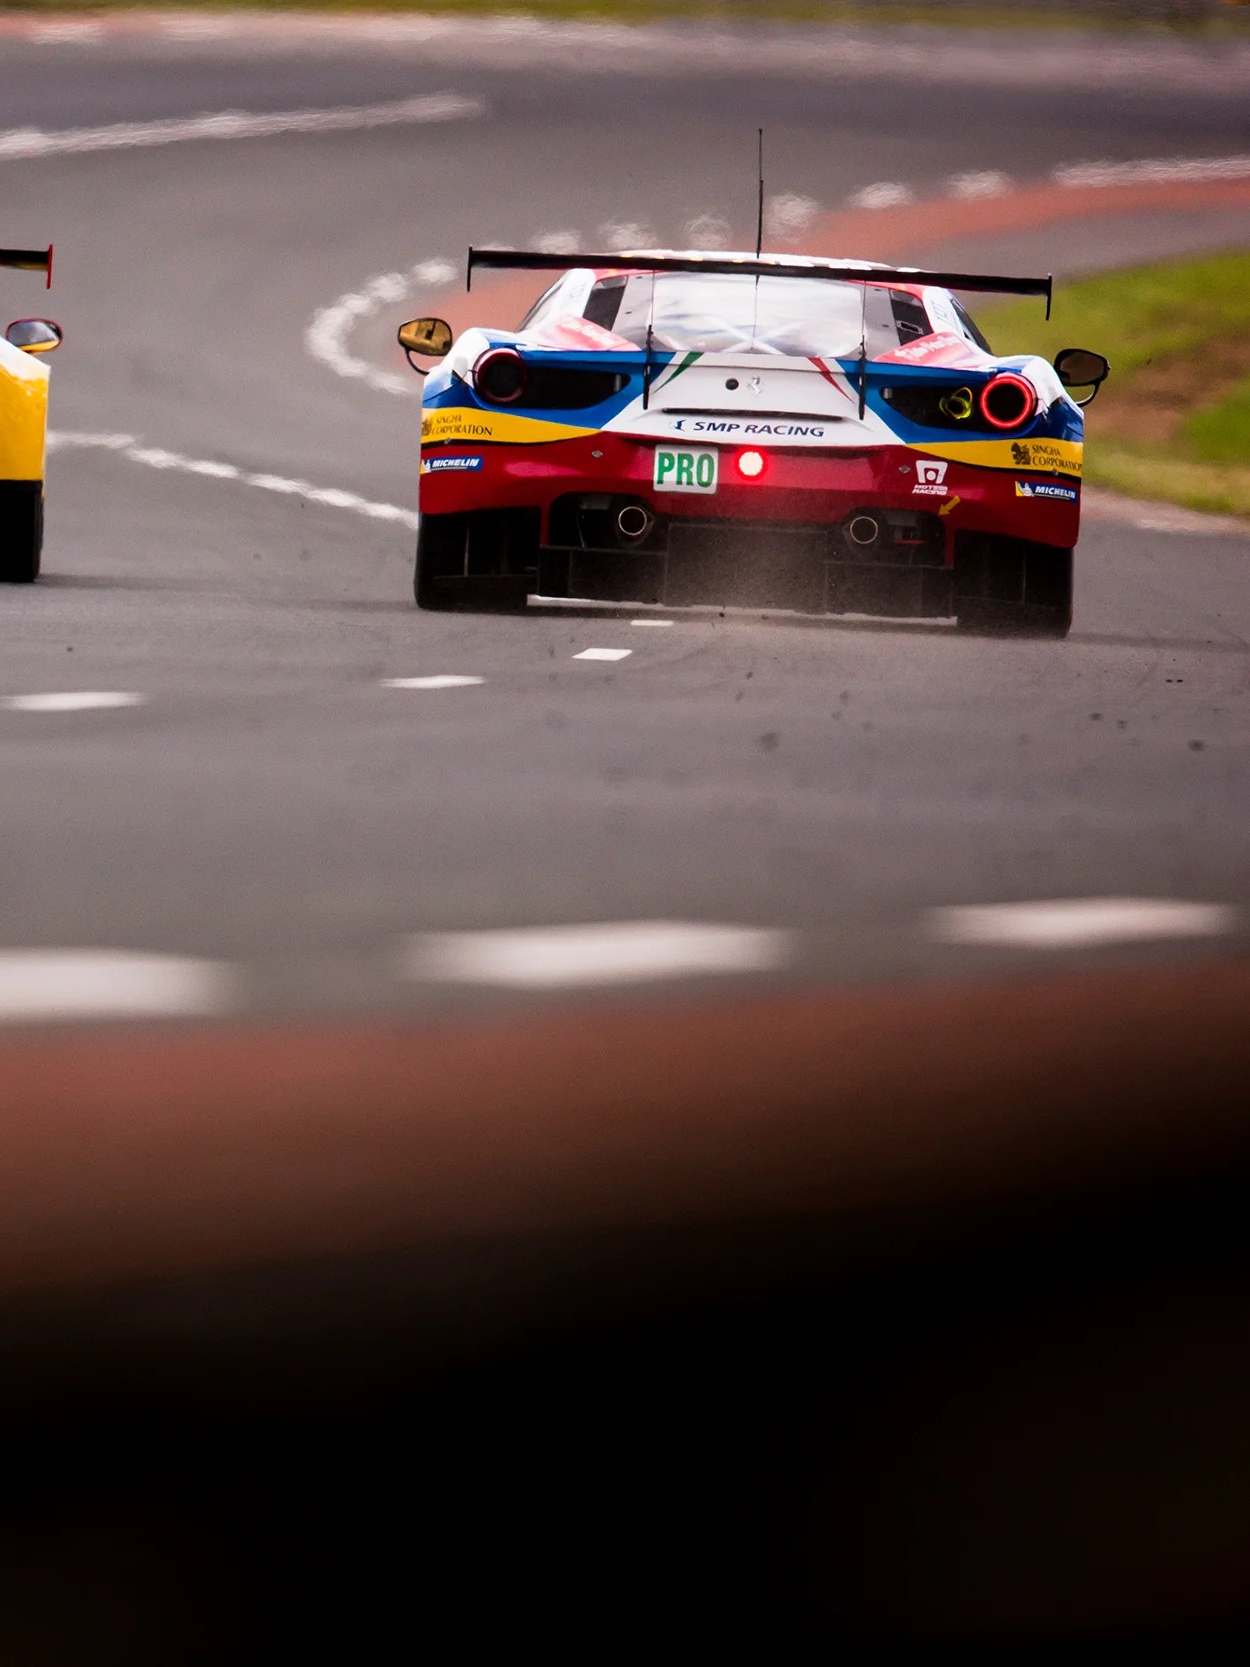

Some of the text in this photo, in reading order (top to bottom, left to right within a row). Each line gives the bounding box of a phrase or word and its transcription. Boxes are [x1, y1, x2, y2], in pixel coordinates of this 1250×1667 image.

[431, 424, 493, 436] CORPORATION
[693, 421, 826, 438] SMP RACING
[1031, 444, 1062, 458] SINGHA
[432, 458, 480, 468] MICHELIN
[657, 452, 715, 488] PRO
[1035, 486, 1076, 499] MICHELIN
